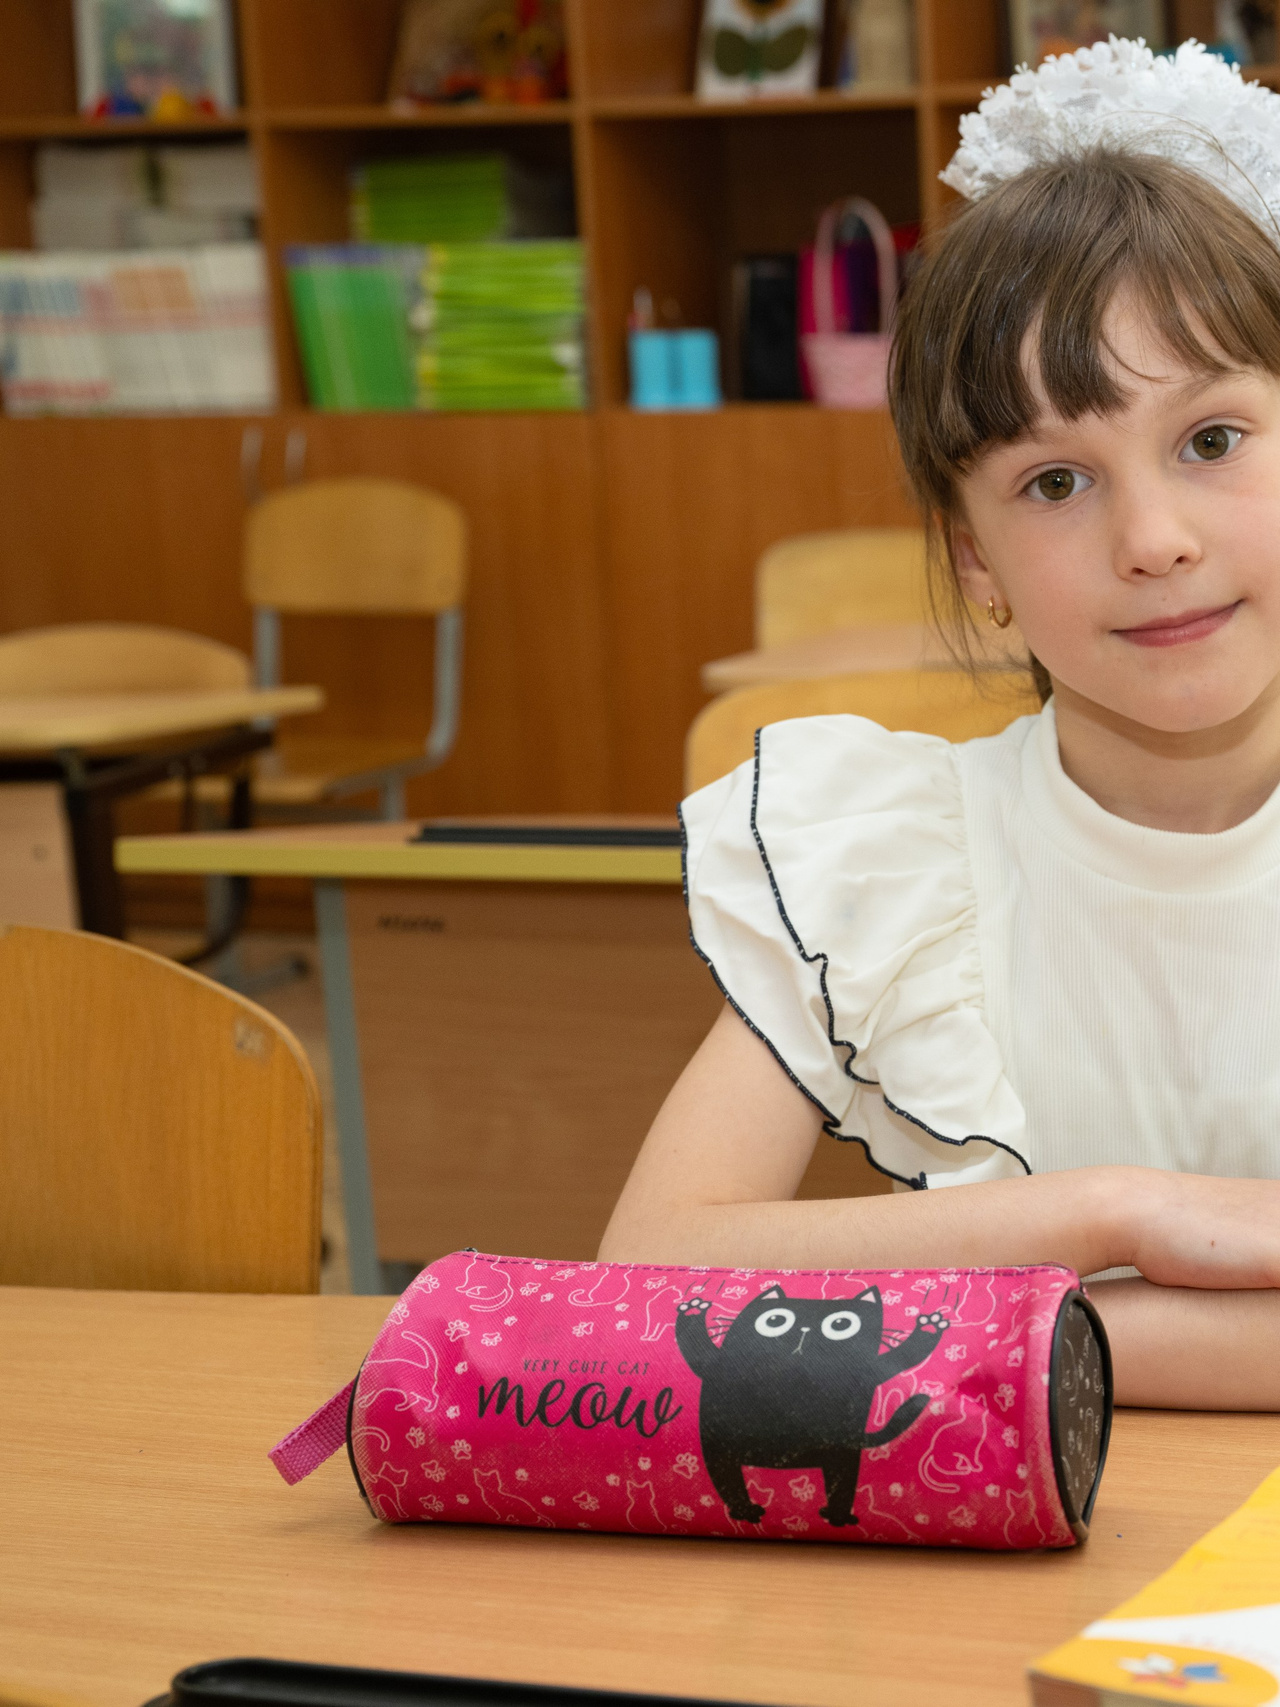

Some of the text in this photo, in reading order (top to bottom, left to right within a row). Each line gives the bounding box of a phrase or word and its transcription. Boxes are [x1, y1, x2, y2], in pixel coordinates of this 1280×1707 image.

[523, 1359, 650, 1376] VERY CUTE CAT
[477, 1376, 684, 1439] meow
